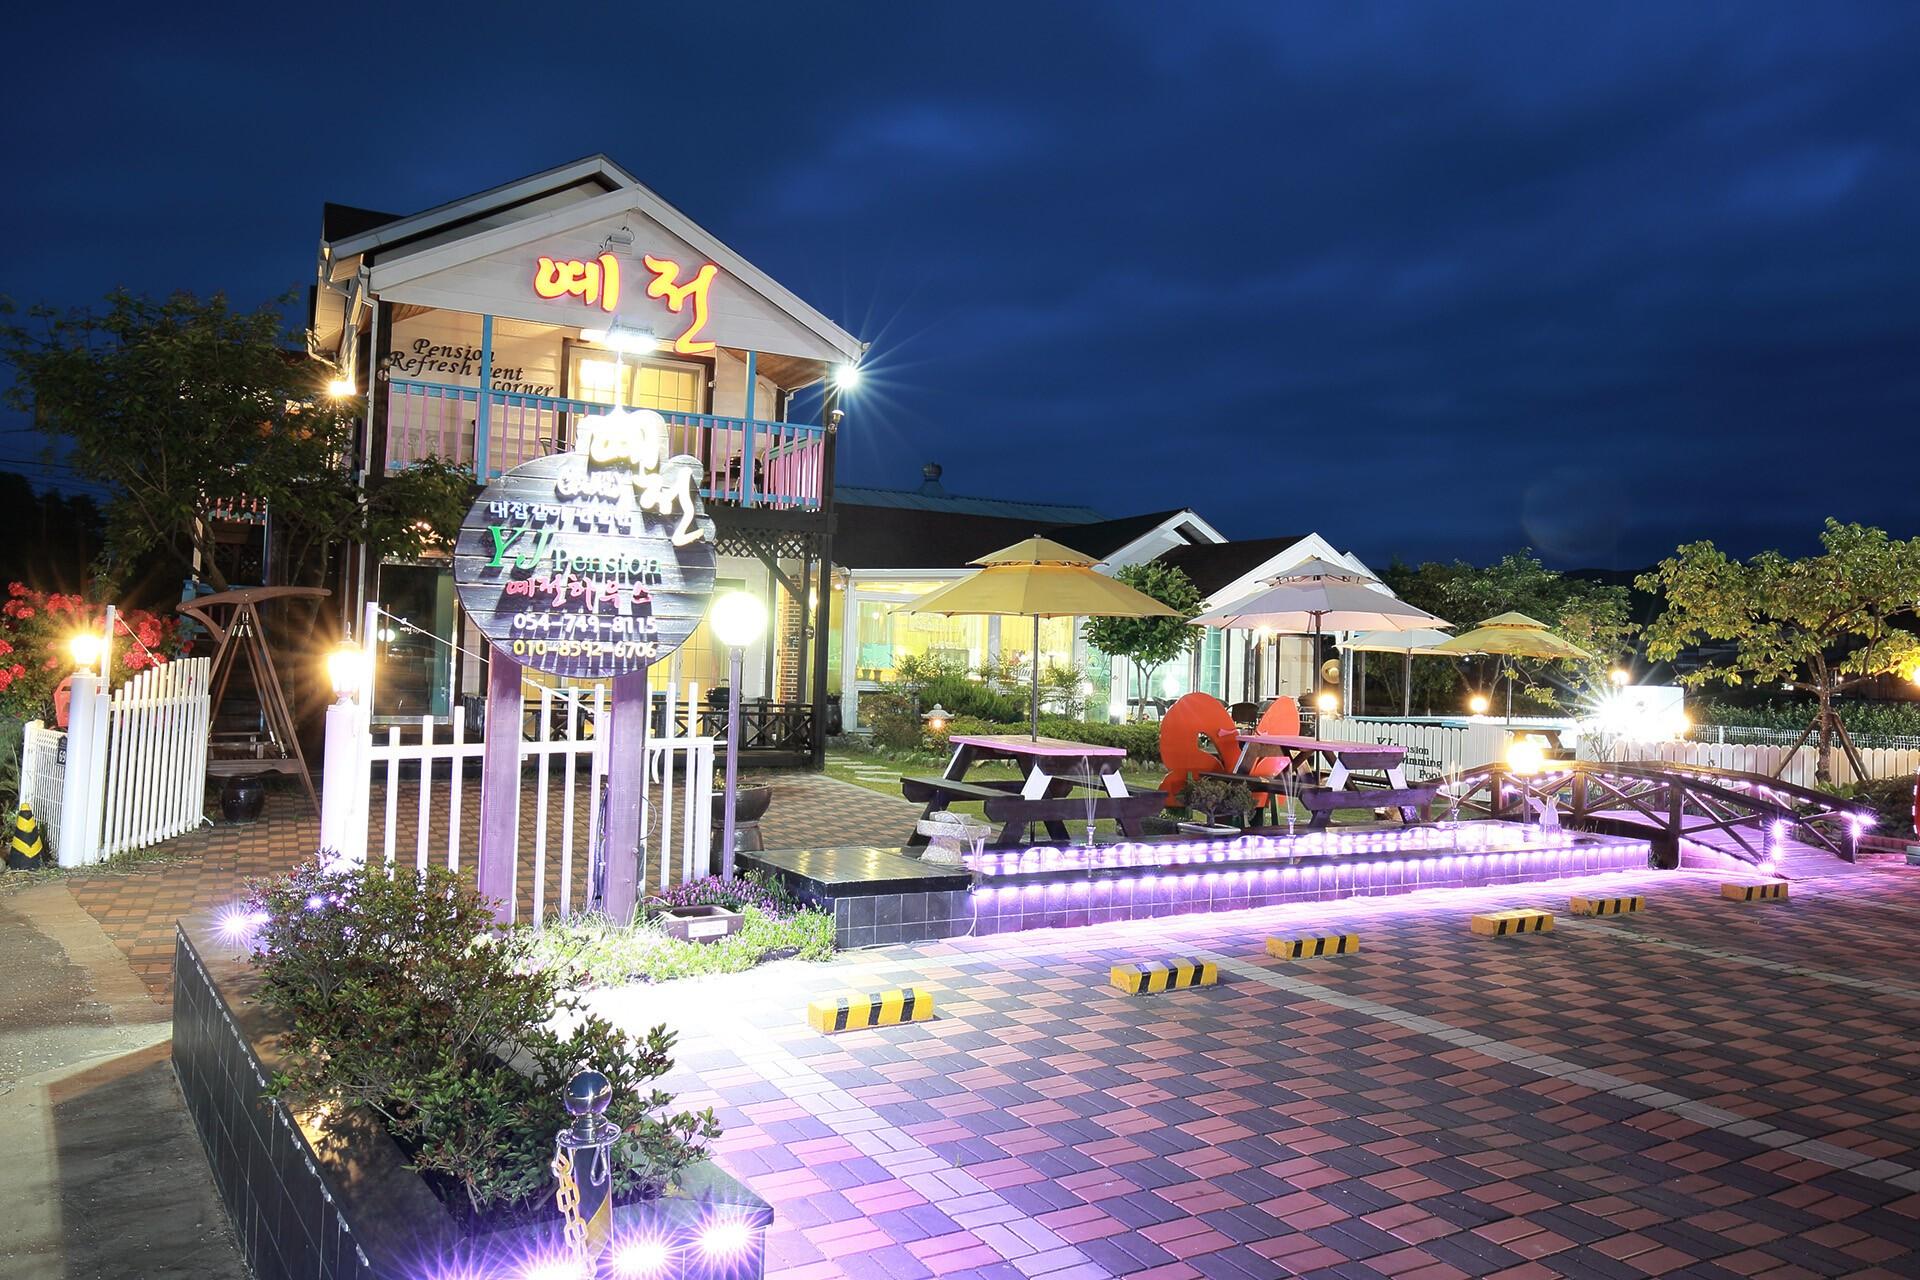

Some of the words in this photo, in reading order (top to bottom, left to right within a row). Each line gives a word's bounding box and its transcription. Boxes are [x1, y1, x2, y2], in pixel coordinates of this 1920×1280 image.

[390, 350, 524, 381] Refreshent
[492, 380, 554, 397] corner
[486, 525, 554, 570] YJ
[553, 549, 662, 574] Pension
[513, 613, 658, 634] 054-749-8115
[513, 639, 658, 660] 010-8592-6706
